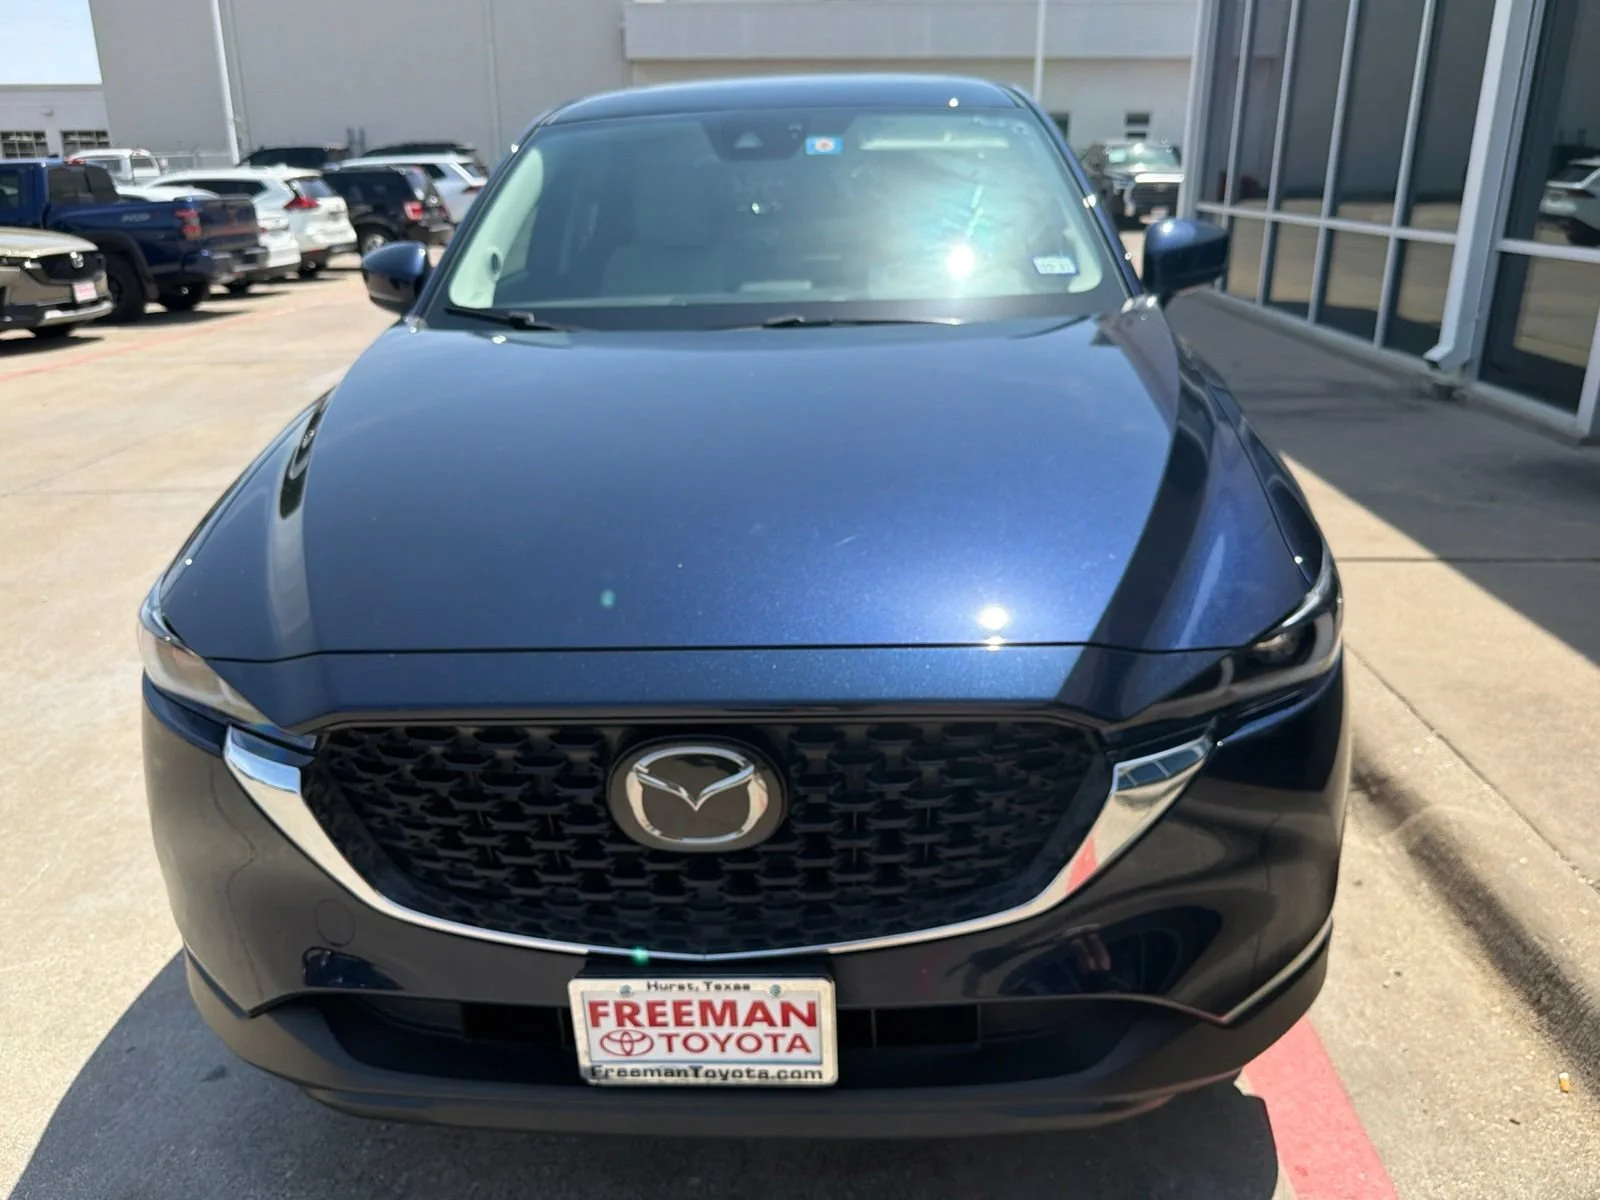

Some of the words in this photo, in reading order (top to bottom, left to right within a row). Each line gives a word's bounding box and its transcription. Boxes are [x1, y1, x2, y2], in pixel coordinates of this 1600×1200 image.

[703, 980, 751, 992] Texas
[588, 1000, 818, 1028] FREEMAN
[658, 1032, 813, 1054] TOYOTA
[591, 1064, 824, 1081] FreemanToyota.com
